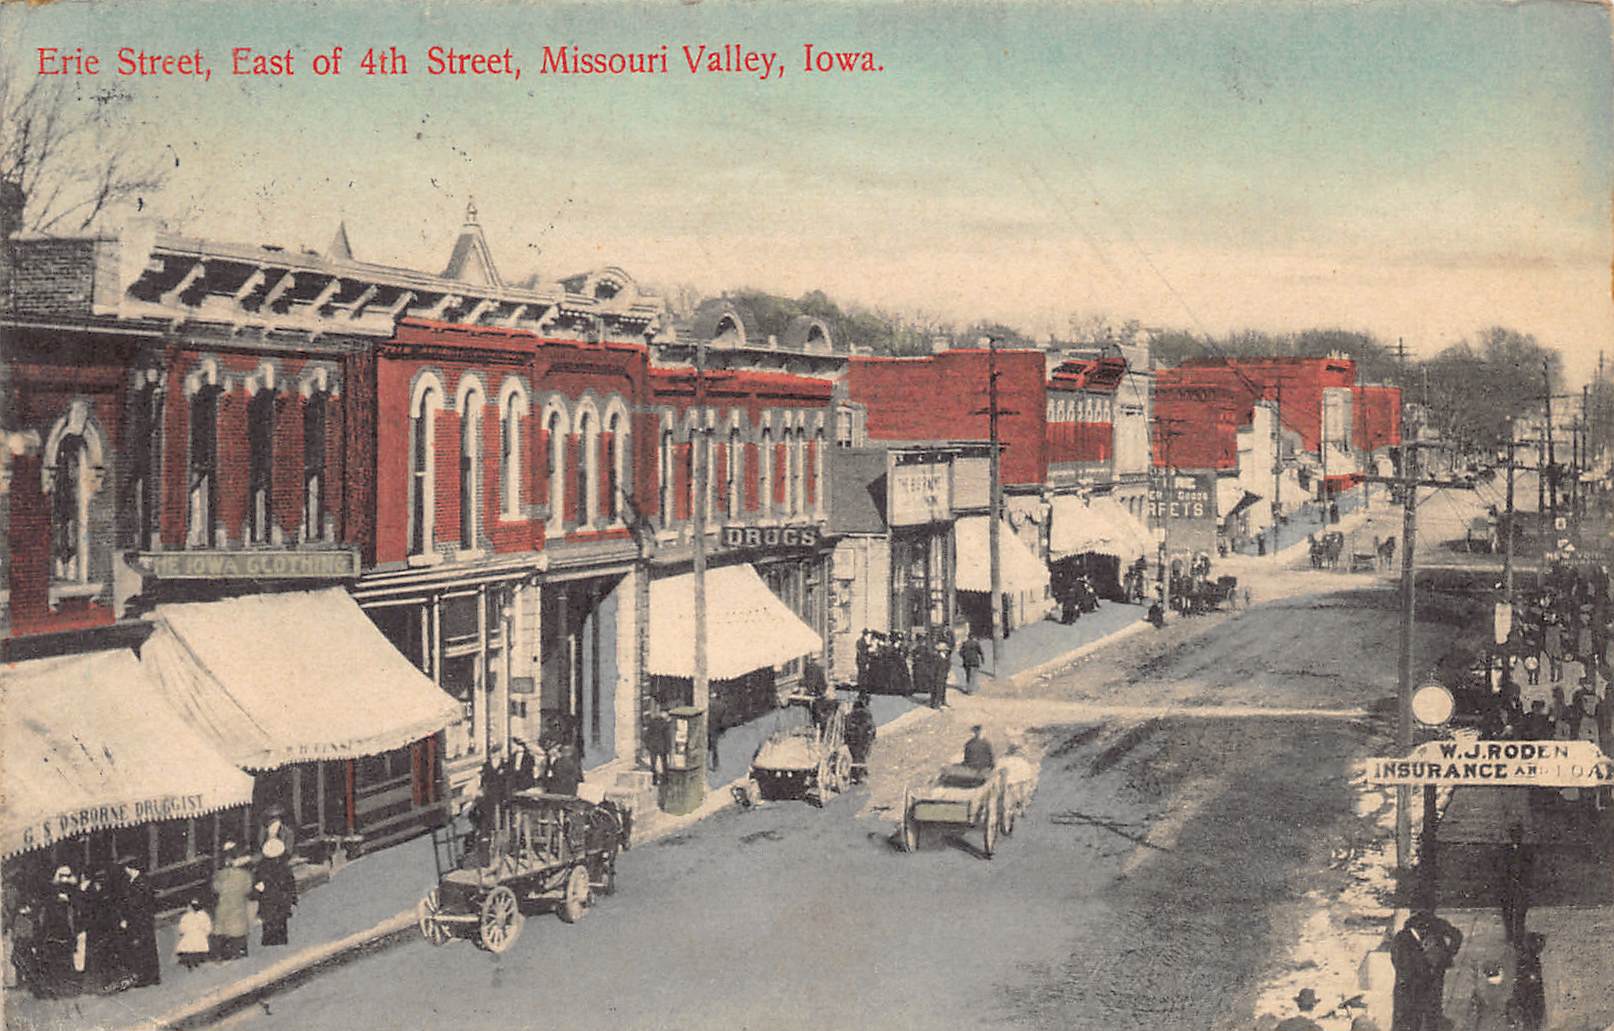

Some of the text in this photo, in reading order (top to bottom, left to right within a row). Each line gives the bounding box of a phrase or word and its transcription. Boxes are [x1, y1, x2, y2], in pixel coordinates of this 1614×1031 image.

[727, 527, 816, 547] DRUGS
[1374, 762, 1508, 778] INSURANCE
[59, 804, 128, 832] OSBORNE
